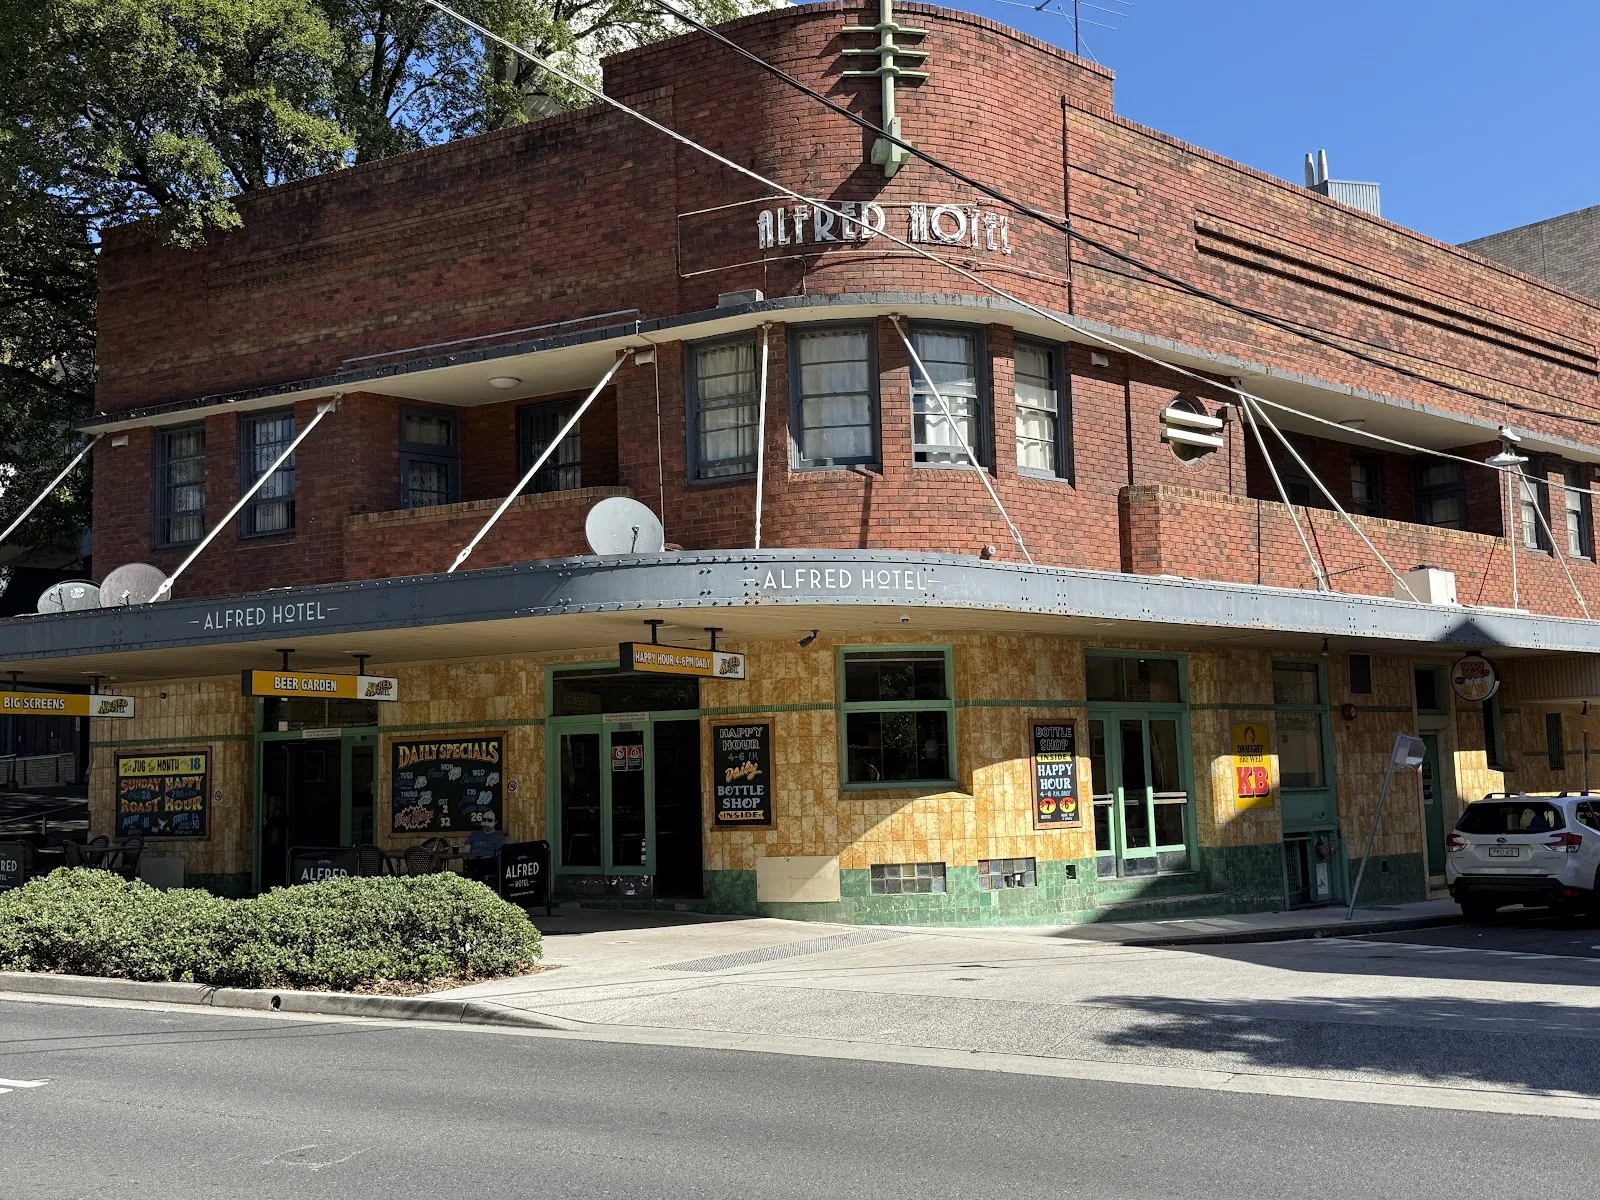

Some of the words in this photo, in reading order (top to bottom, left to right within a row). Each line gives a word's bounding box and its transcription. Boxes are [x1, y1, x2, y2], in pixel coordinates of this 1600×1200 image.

[757, 200, 886, 249] ALFRED
[908, 202, 1011, 254] HOTEL
[763, 568, 852, 590] ALFRED
[862, 569, 927, 591] HOTEL
[204, 608, 266, 630] ALFRED
[273, 602, 326, 624] HOTEL
[635, 651, 655, 664] HAPPY
[657, 653, 674, 667] HOUR
[695, 657, 710, 670] DAILY
[274, 677, 299, 691] BEER
[301, 679, 337, 693] GARDEN
[4, 697, 20, 708] BIG
[23, 698, 65, 710] SCREENS
[719, 726, 763, 739] HAPPY
[1036, 726, 1073, 738] BOTTLE
[722, 739, 760, 751] HOUR
[1039, 738, 1068, 751] SHOP
[1237, 745, 1264, 754] DRAUGHT
[398, 744, 439, 769] DAILY
[439, 742, 499, 764] SPECIALS
[728, 752, 745, 761] 4-6
[1040, 753, 1067, 761] INSIDE
[1239, 755, 1264, 763] BREWED
[133, 760, 145, 772] JUG
[158, 759, 180, 771] MONTH
[1037, 764, 1073, 776] HAPPY
[120, 777, 162, 793] SUNDAY
[165, 776, 204, 792] HAPPY
[1040, 777, 1072, 790] HOUR
[1236, 766, 1270, 798] KB
[717, 785, 764, 796] BOTTLE
[121, 797, 161, 813] ROAST
[164, 796, 203, 812] HOUR
[722, 797, 760, 809] SHOP
[470, 812, 483, 822] 26
[723, 811, 759, 819] INSIDE
[506, 862, 540, 879] ALFRED
